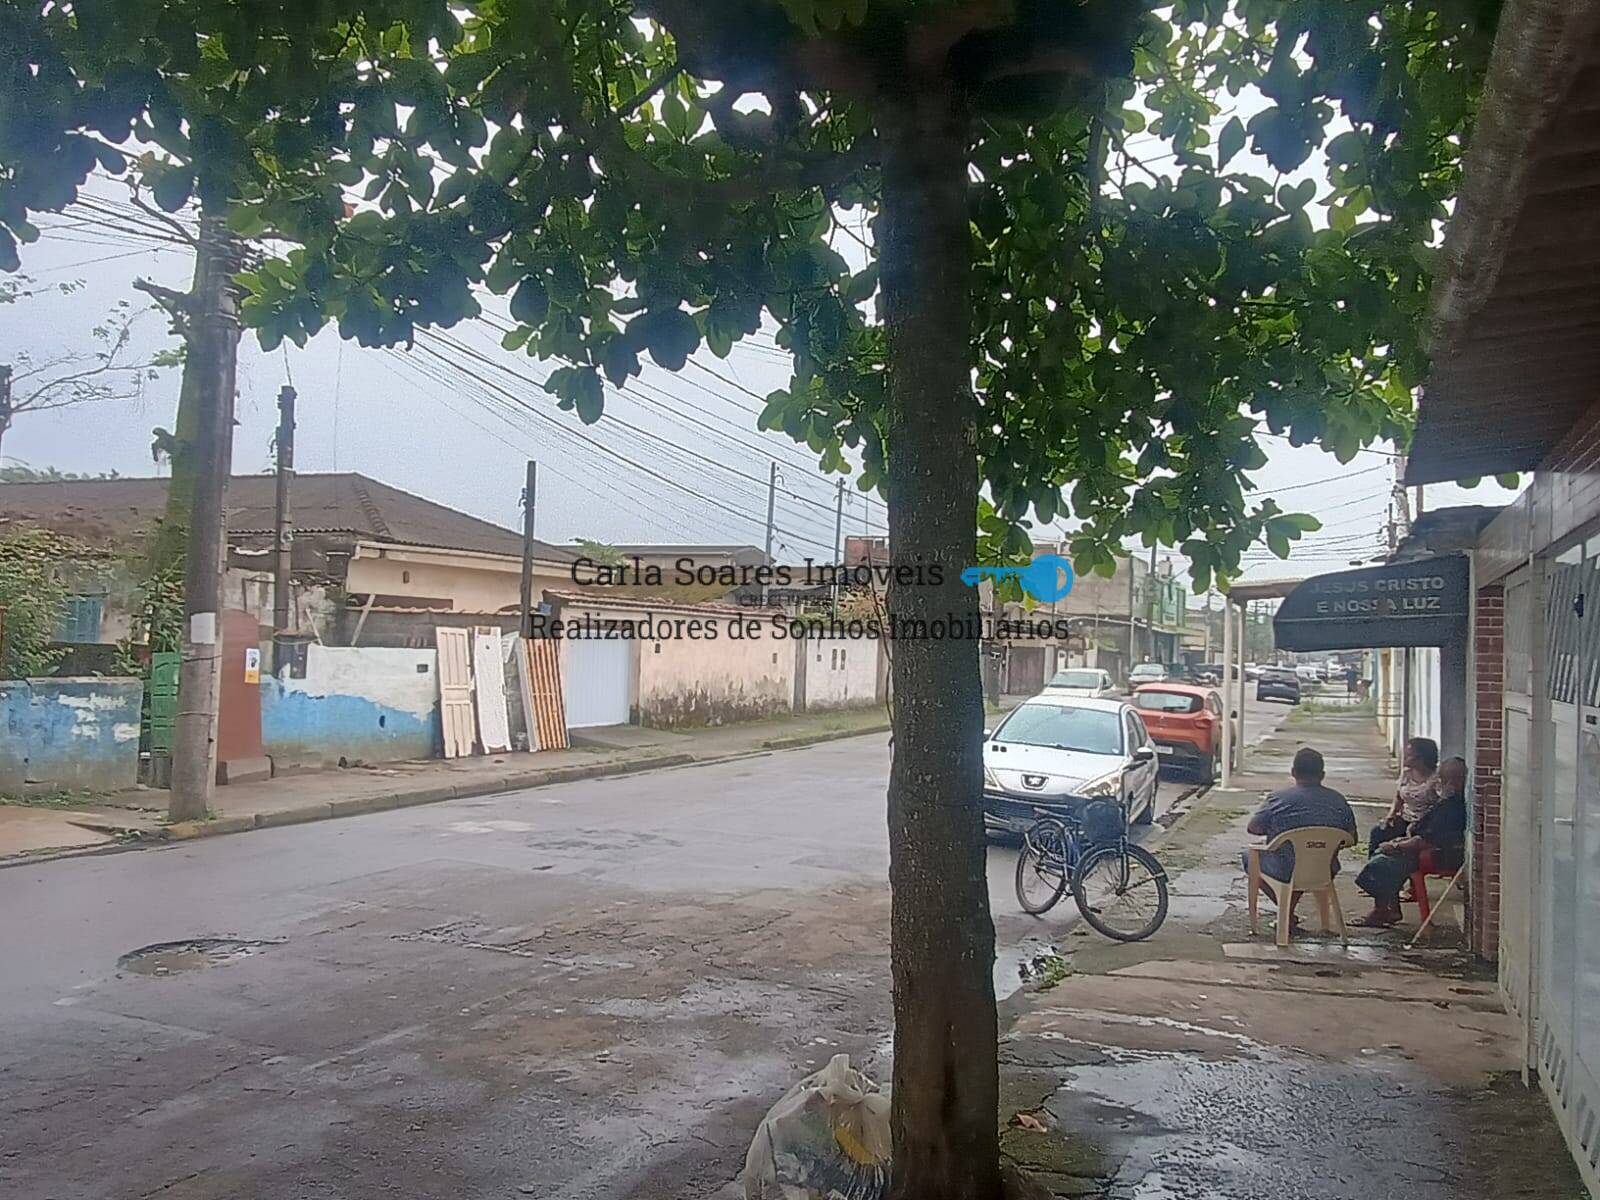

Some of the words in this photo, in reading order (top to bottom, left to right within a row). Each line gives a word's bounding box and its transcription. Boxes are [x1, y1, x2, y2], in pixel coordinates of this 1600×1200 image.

[1374, 576, 1445, 592] CRISTO
[1333, 598, 1397, 613] NOSA
[1402, 596, 1441, 610] LUZ
